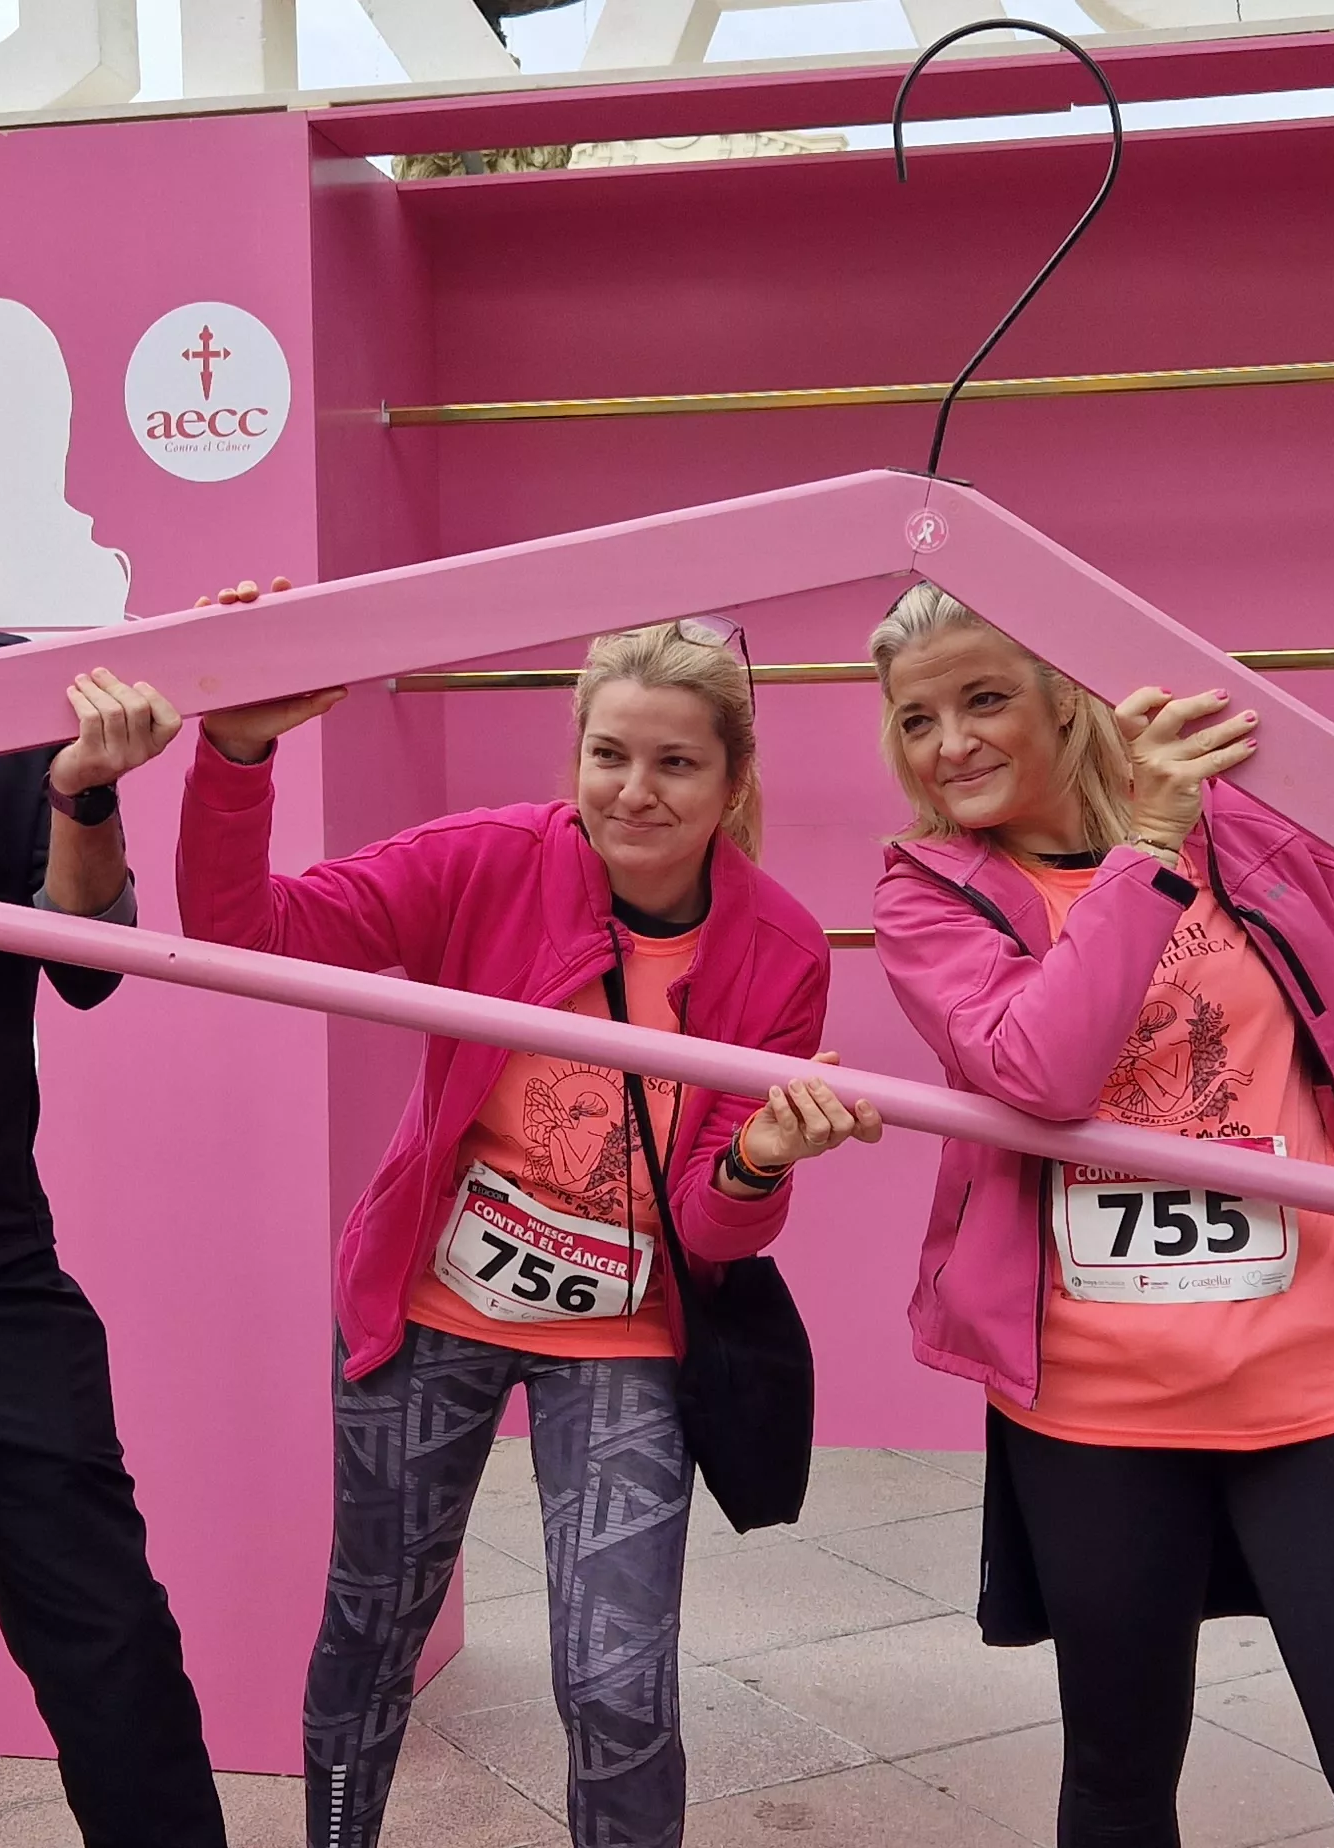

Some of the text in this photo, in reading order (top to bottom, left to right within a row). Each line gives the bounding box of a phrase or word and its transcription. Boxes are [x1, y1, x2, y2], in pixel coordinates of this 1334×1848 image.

[146, 407, 269, 440] aecc
[164, 440, 251, 453] Contra el Cáncer
[1160, 938, 1235, 969] HUESCA
[474, 1200, 628, 1278] CONTRA EL CÁNCER
[527, 1217, 574, 1246] HUESCA
[1097, 1189, 1250, 1258] 755
[474, 1230, 599, 1313] 756
